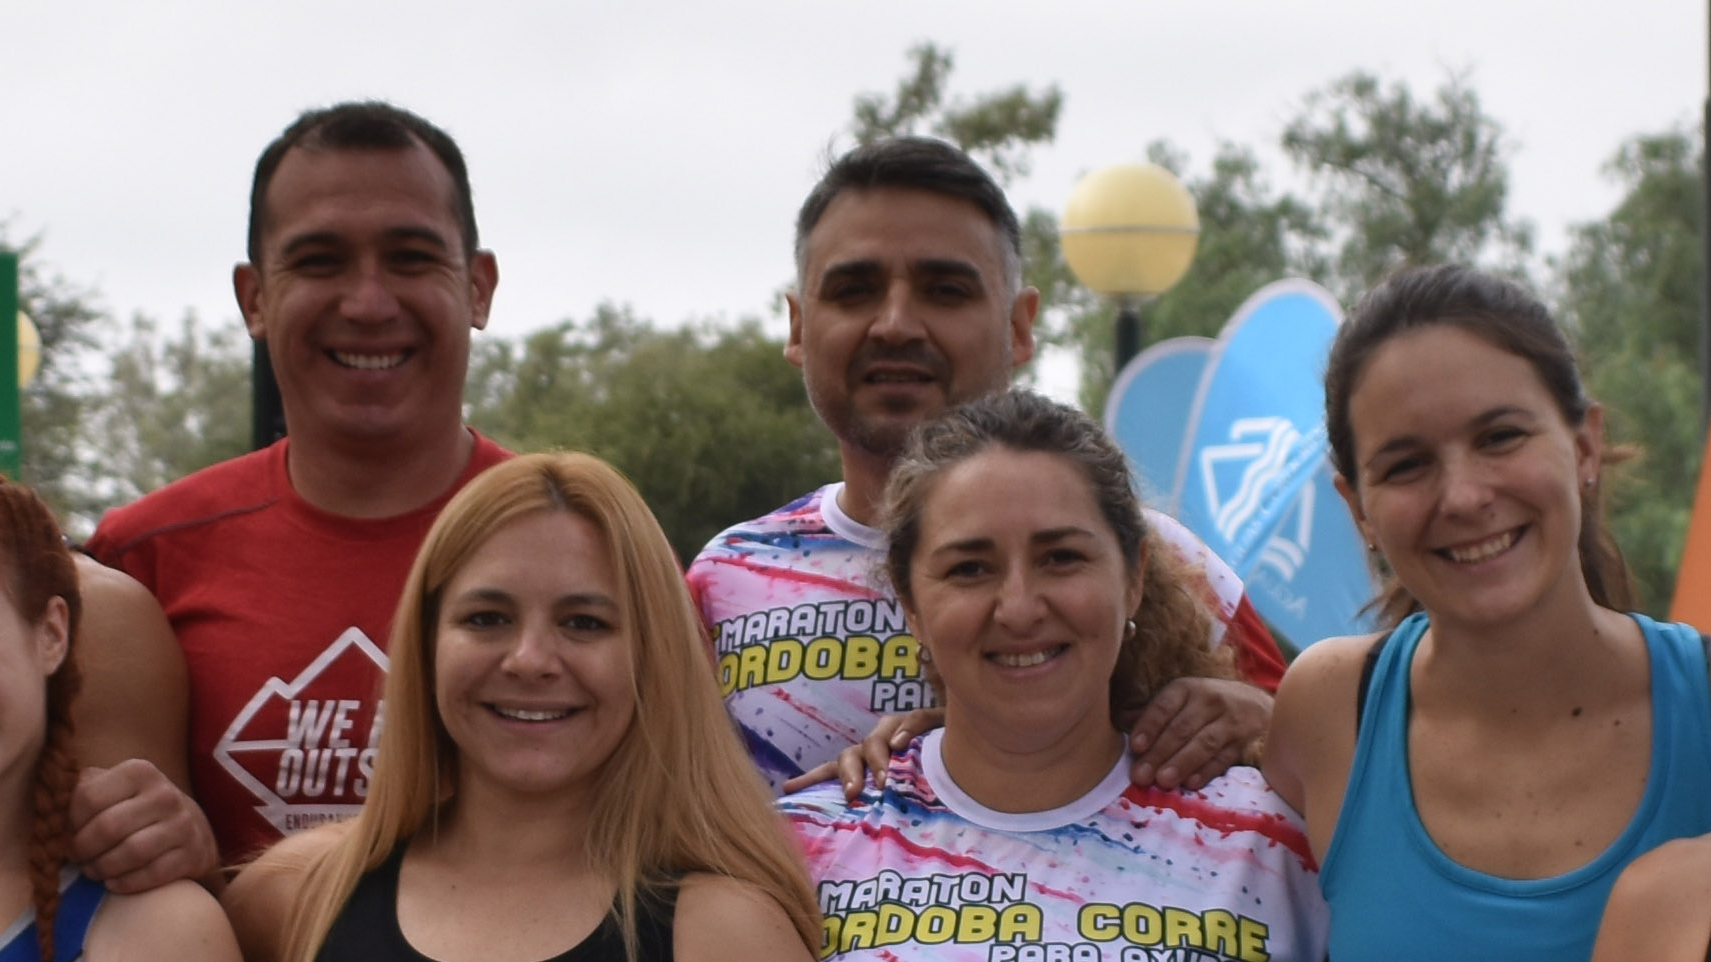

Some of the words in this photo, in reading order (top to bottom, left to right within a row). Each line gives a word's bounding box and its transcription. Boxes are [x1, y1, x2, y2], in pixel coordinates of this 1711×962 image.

[719, 598, 906, 651] MARATON
[717, 633, 921, 698] ORDOBA
[287, 699, 360, 749] WE
[818, 869, 1027, 914] MARATON
